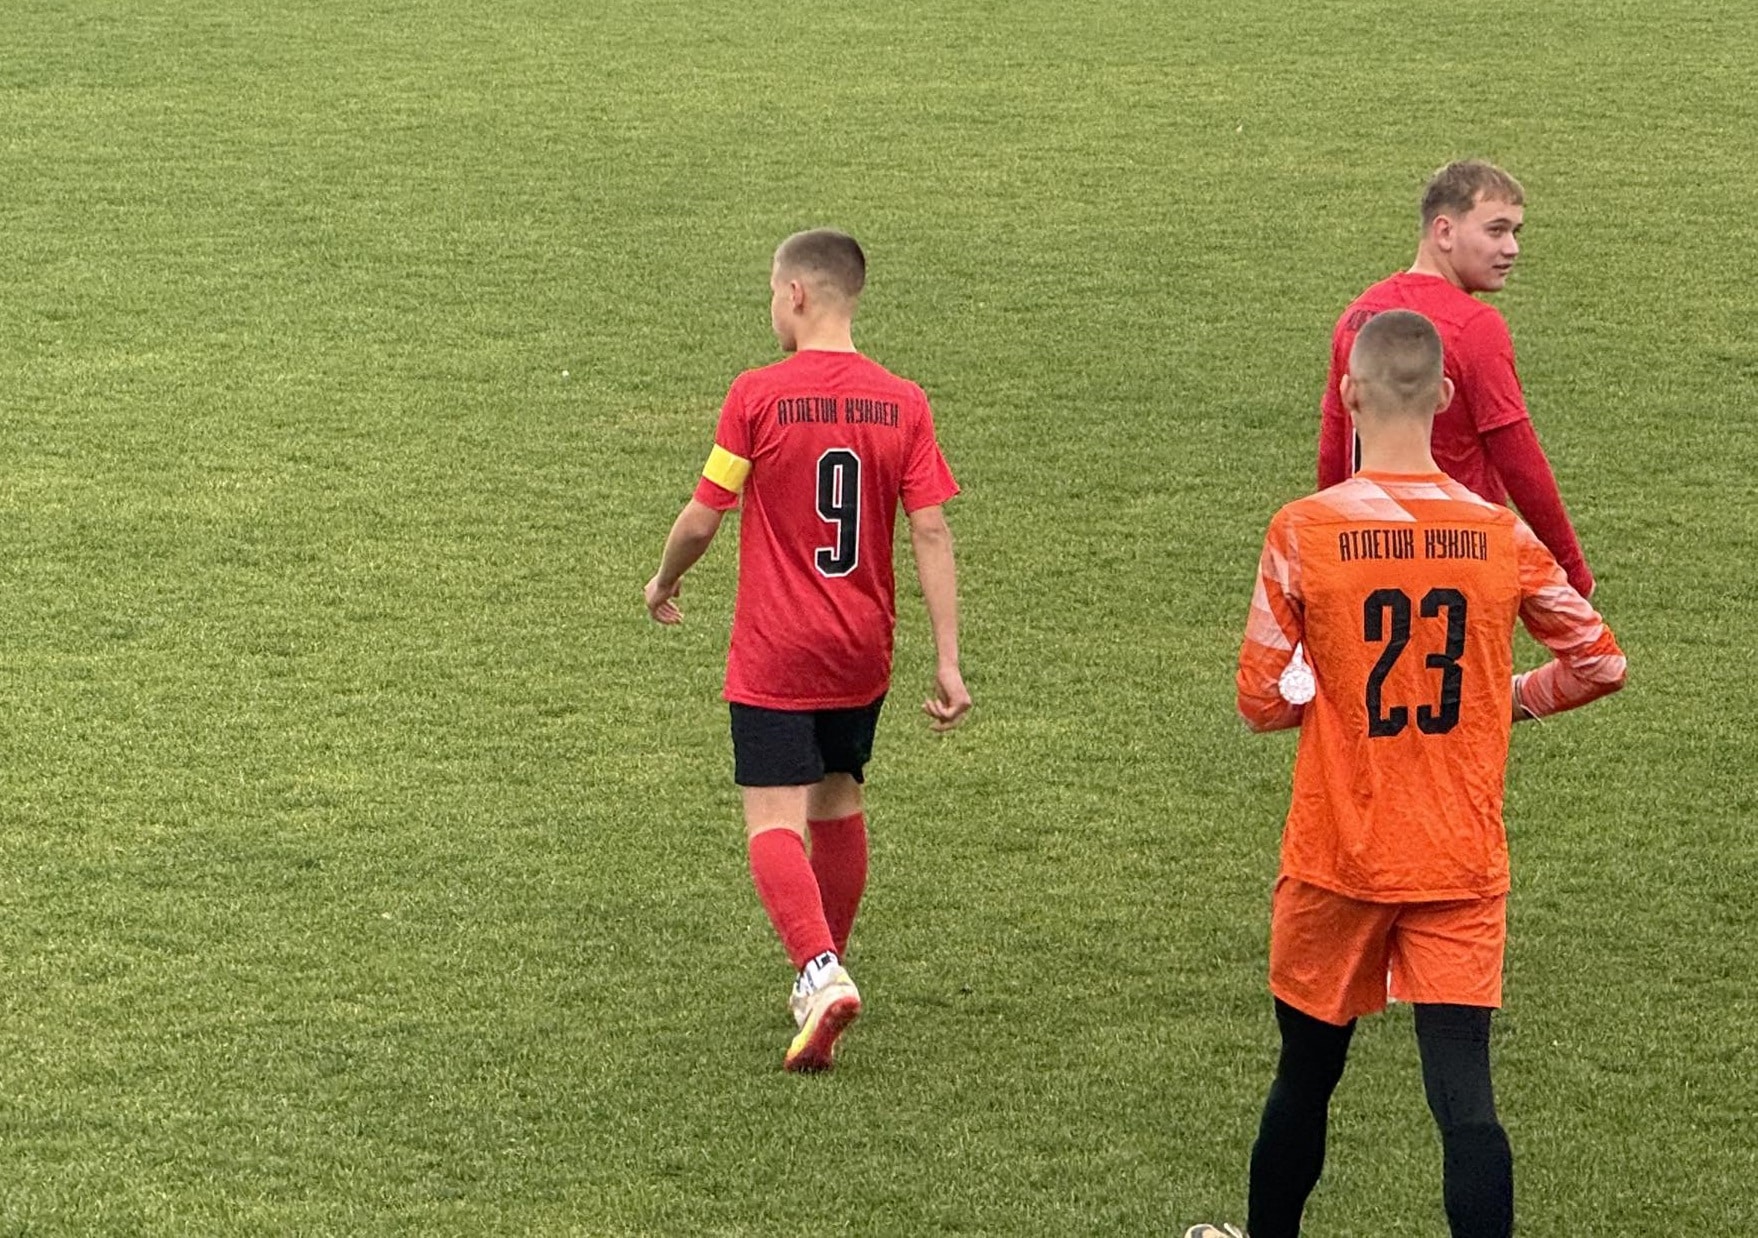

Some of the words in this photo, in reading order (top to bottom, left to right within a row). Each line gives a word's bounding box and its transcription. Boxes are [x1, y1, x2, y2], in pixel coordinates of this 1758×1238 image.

[778, 397, 837, 426] АТЛЕТИК
[845, 398, 898, 427] КУКЛЕН
[815, 448, 861, 577] 9
[1339, 529, 1414, 561] АТЛЕТИК
[1424, 529, 1487, 560] КУКЛЕН
[1364, 588, 1467, 737] 23
